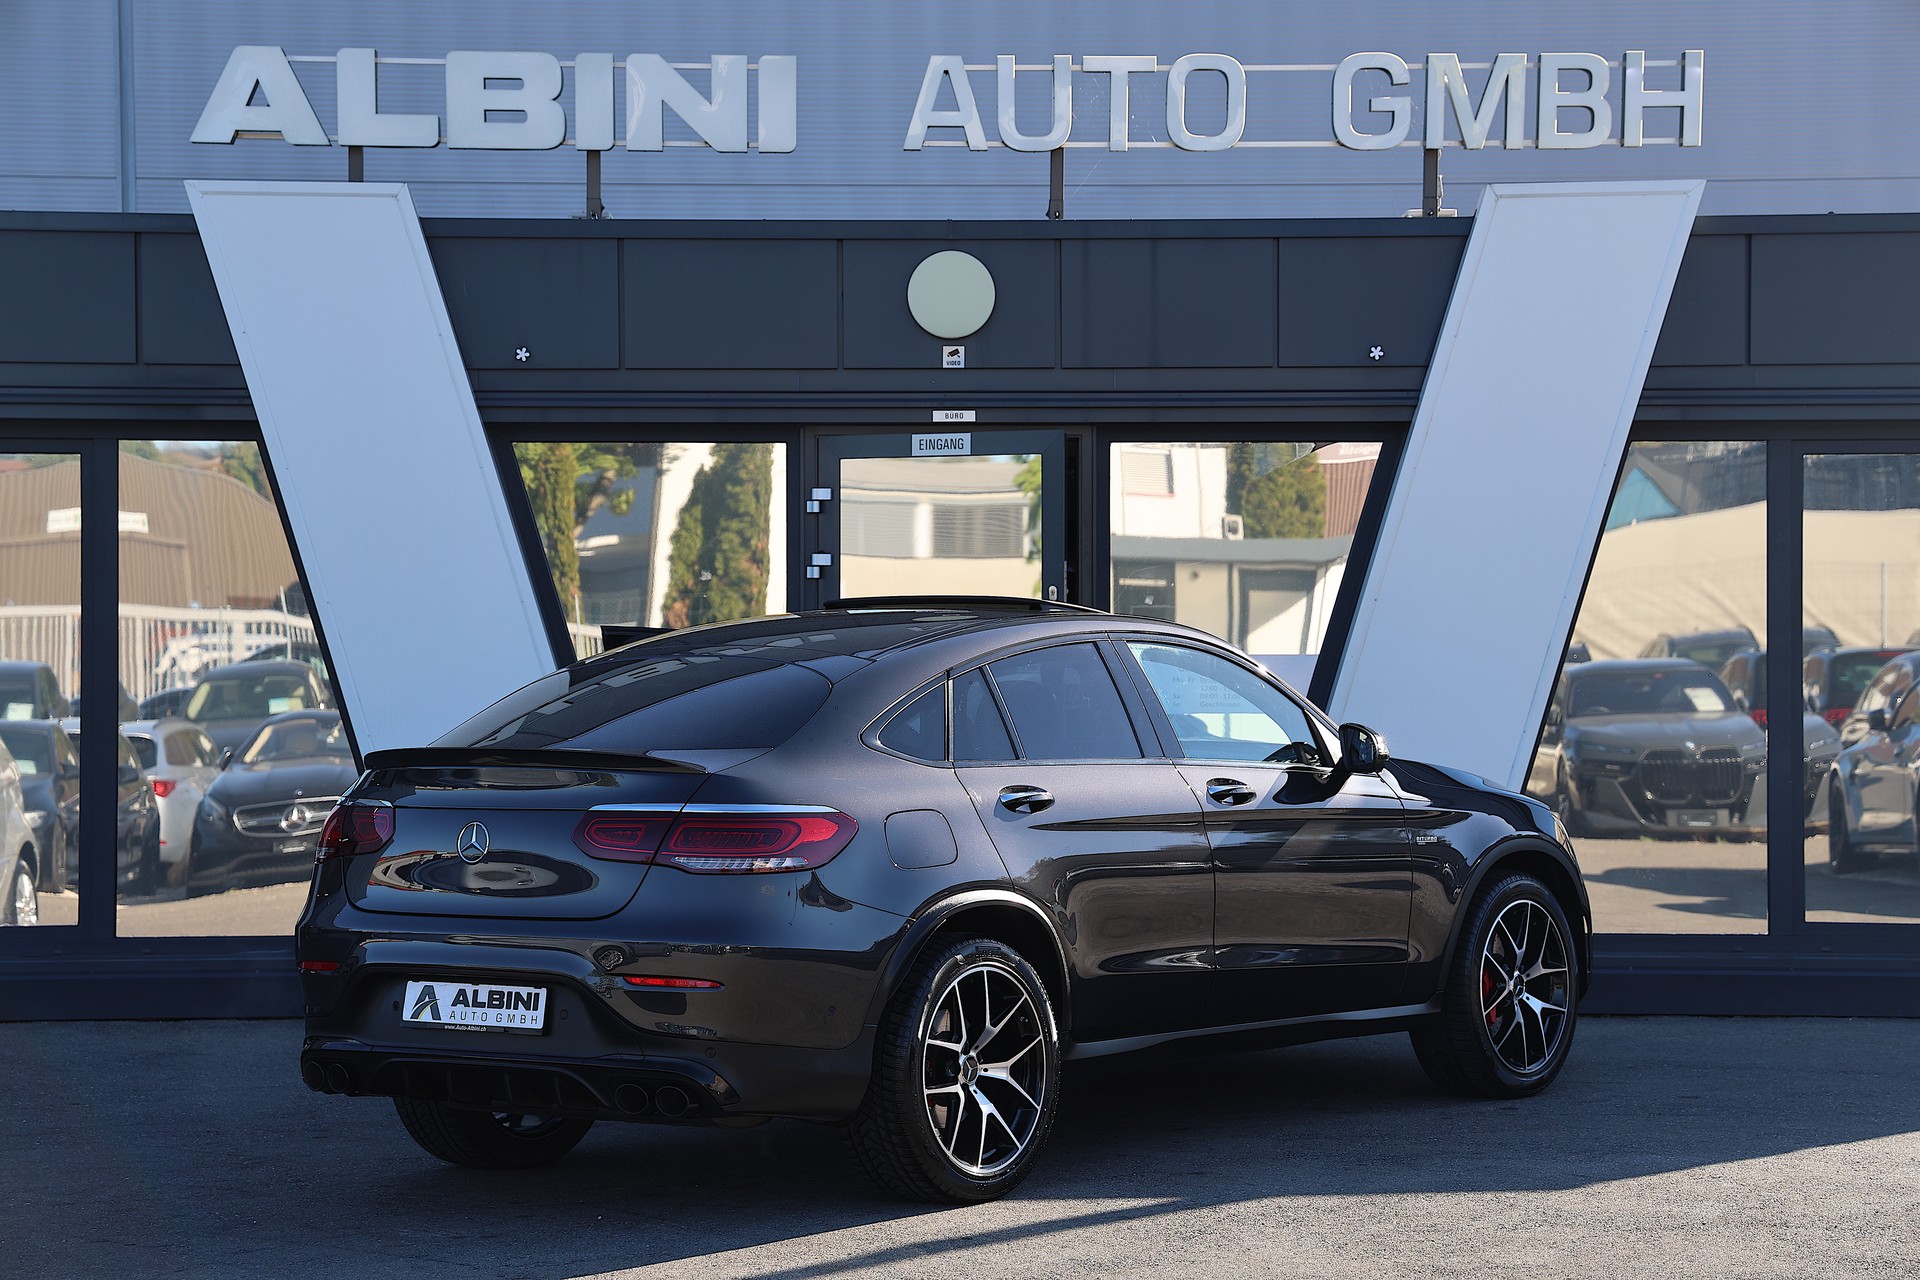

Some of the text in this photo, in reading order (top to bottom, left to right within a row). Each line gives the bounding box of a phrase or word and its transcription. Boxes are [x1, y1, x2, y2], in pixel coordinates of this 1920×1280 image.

[190, 45, 1704, 153] ALBINI AUTO GMBH
[945, 411, 964, 419] BÜRO
[919, 438, 964, 450] EINGANG
[451, 988, 540, 1011] ALBINI
[449, 1010, 538, 1025] AUTO GMBH
